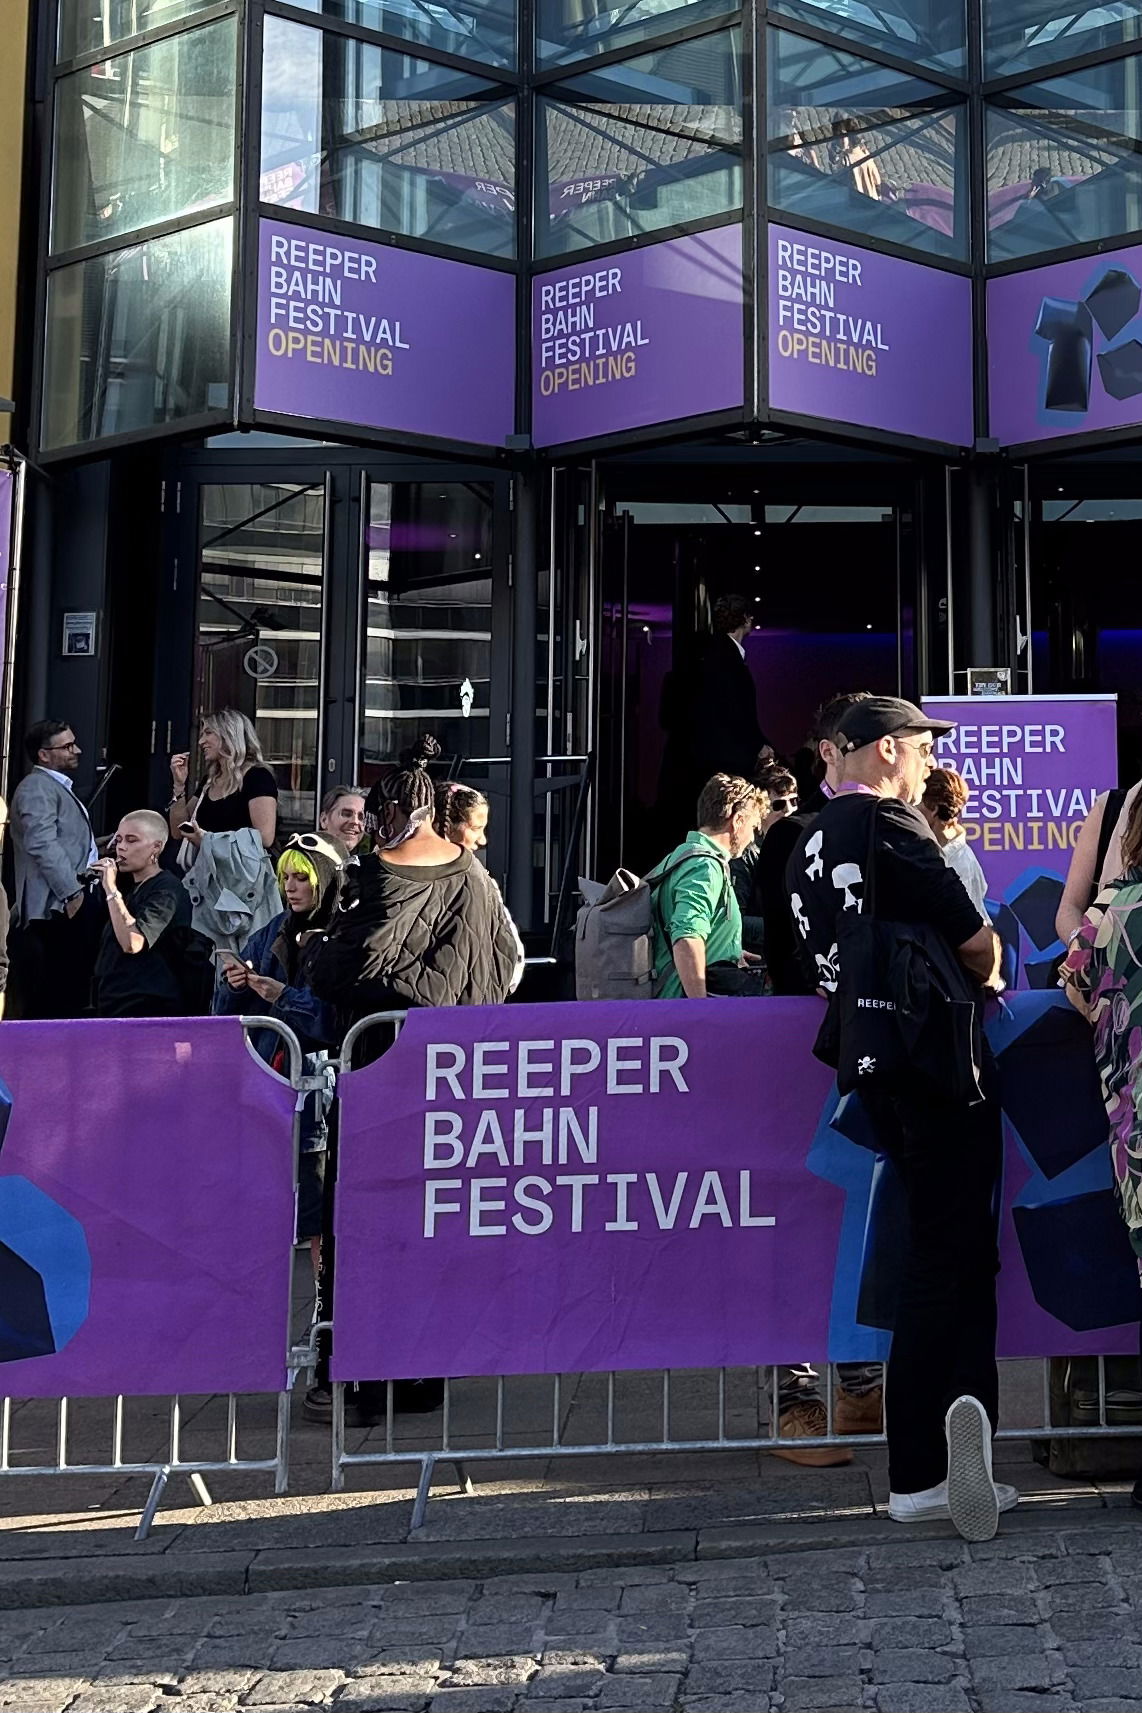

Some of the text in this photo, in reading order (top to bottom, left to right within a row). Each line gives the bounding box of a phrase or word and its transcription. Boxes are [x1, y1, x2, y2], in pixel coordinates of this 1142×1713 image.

[271, 235, 376, 282] REEPER
[778, 240, 861, 286] REEPER
[271, 266, 340, 305] BAHN
[541, 268, 622, 311] REEPER
[779, 270, 833, 307] BAHN
[271, 297, 409, 348] FESTIVAL
[541, 303, 594, 339] BAHN
[542, 321, 649, 367] FESTIVAL
[779, 300, 888, 350] FESTIVAL
[268, 328, 393, 376] OPENING
[541, 352, 635, 395] OPENING
[778, 329, 876, 376] OPENING
[962, 788, 1097, 818] ESTIVA
[857, 998, 896, 1011] REEPE
[426, 1036, 690, 1101] REEPER
[424, 1106, 598, 1169] BAHN
[424, 1170, 776, 1238] FESTIVAL
